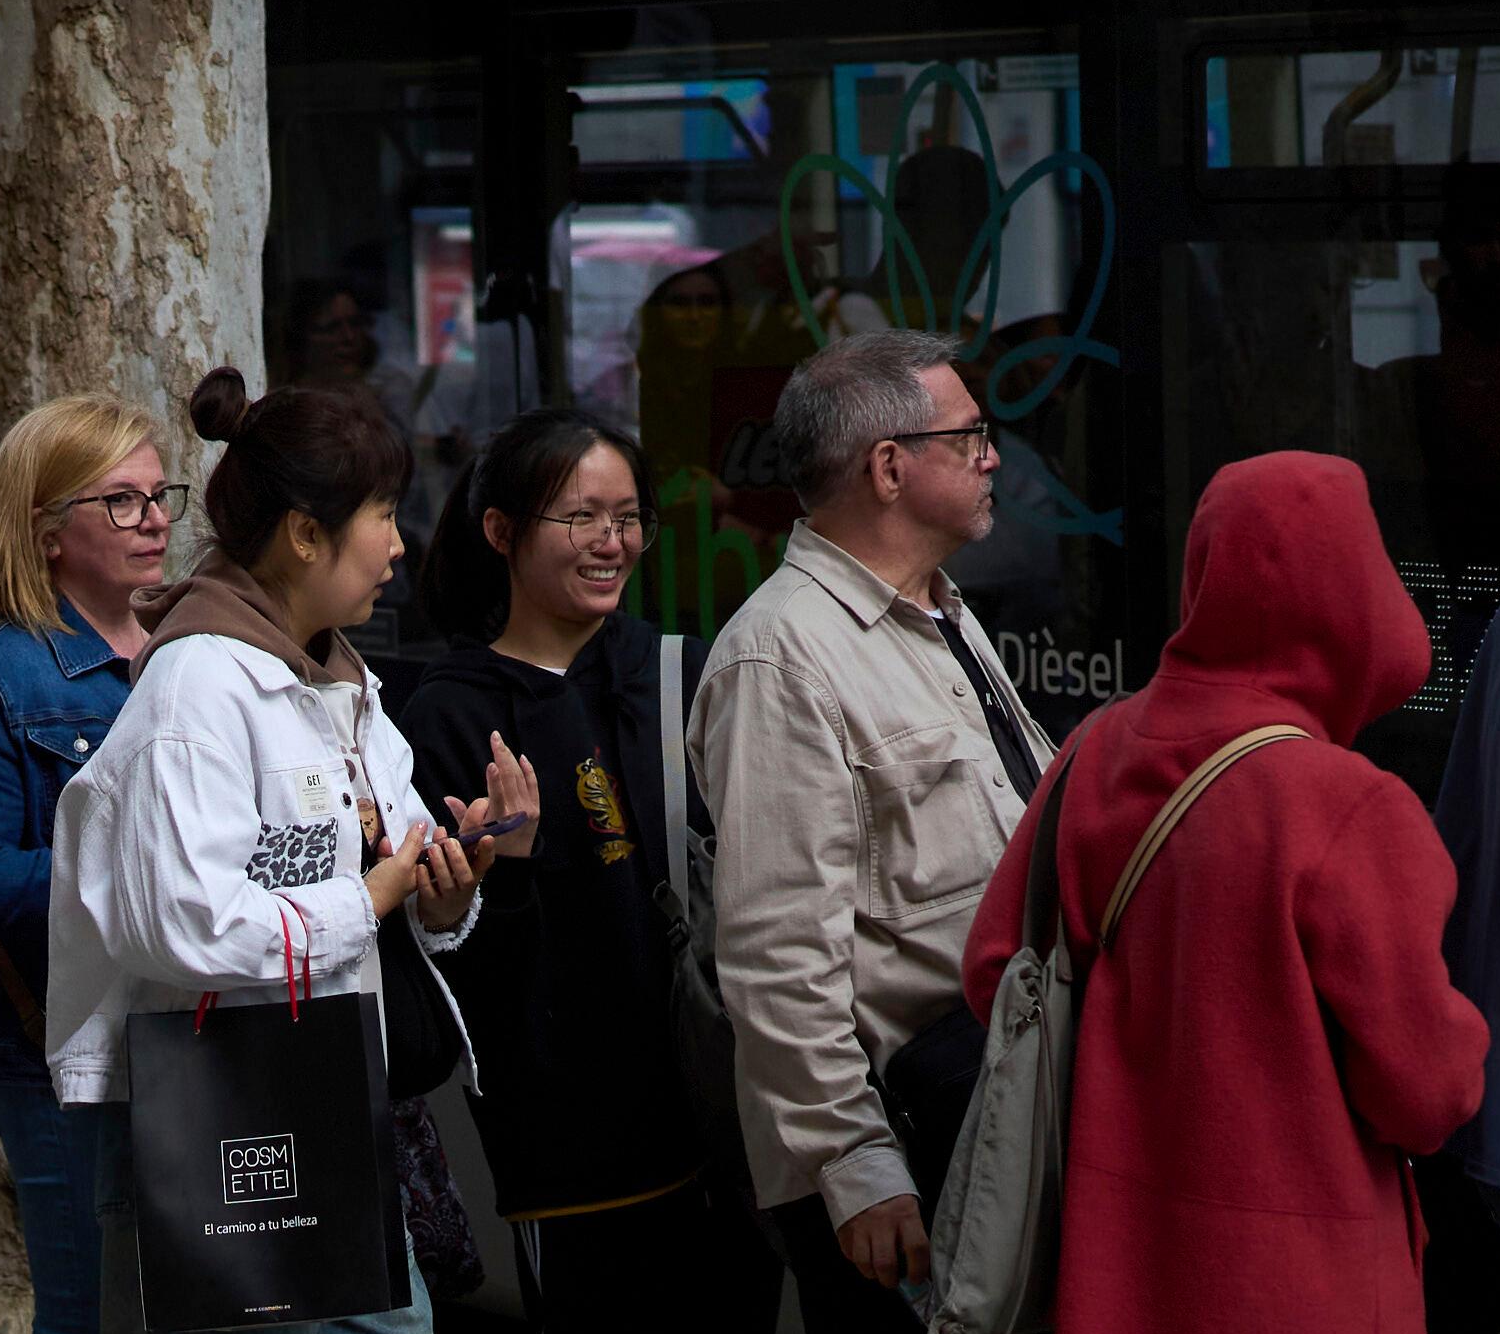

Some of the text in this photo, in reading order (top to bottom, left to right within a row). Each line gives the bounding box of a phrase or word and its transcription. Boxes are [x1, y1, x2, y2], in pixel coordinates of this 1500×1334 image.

[997, 626, 1128, 700] Dièsel
[306, 774, 321, 787] GET
[229, 1144, 288, 1169] COSM
[231, 1169, 290, 1194] ETTEI
[204, 1215, 318, 1236] El camino a tu belleza
